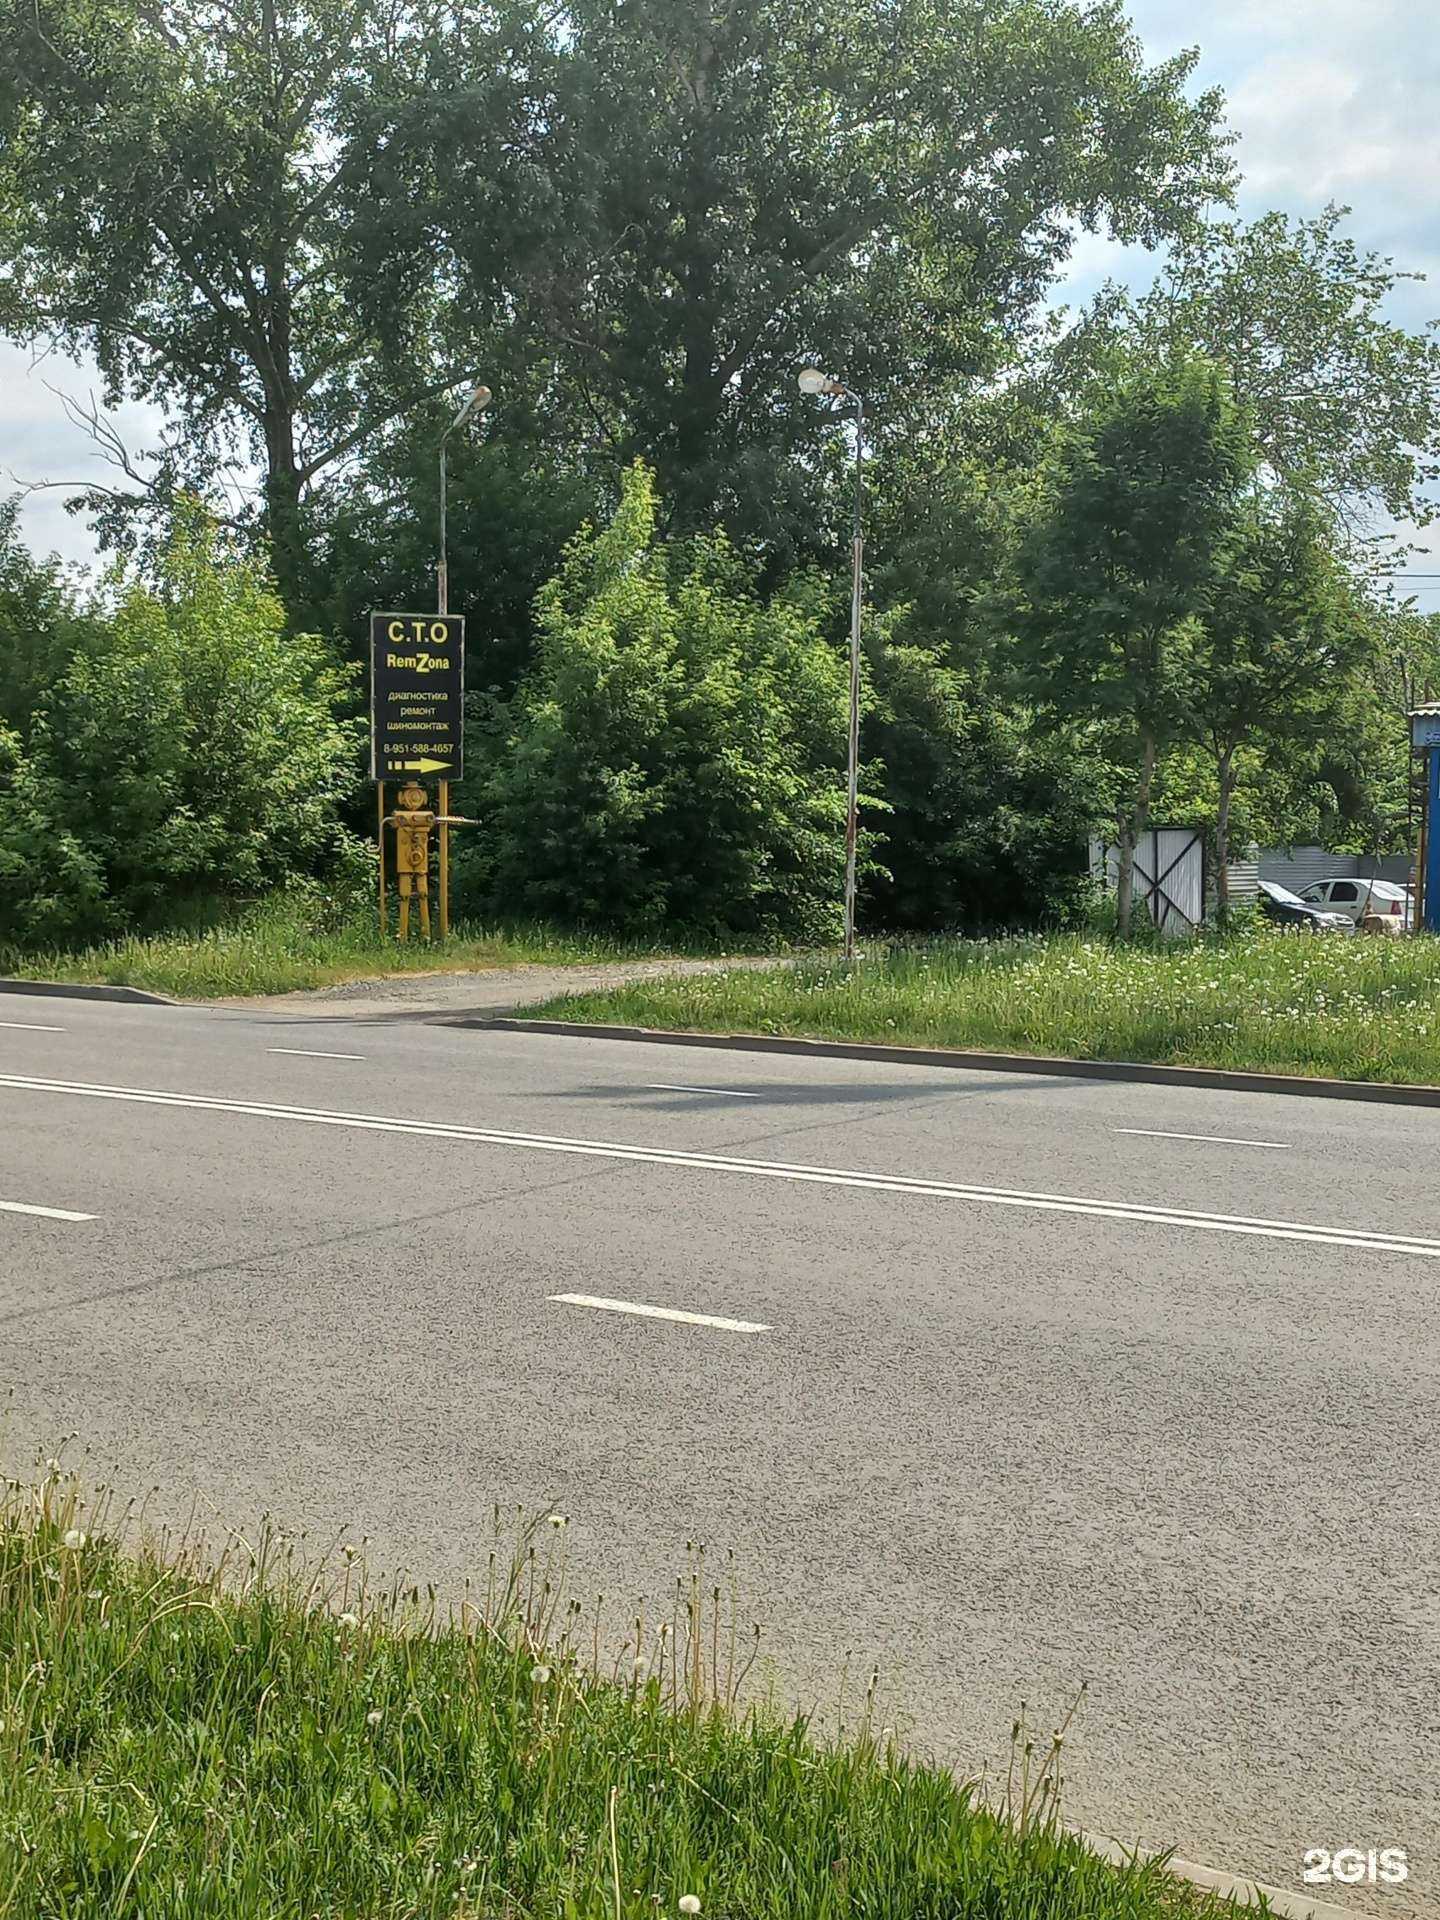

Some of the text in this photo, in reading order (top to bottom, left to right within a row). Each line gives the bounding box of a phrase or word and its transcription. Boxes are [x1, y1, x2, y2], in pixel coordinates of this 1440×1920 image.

[386, 653, 450, 673] RemZona
[388, 691, 449, 701] диагностика
[400, 707, 436, 717] ремонт
[387, 722, 450, 731] шиномонтаж
[383, 743, 455, 754] 8-951-588-4657
